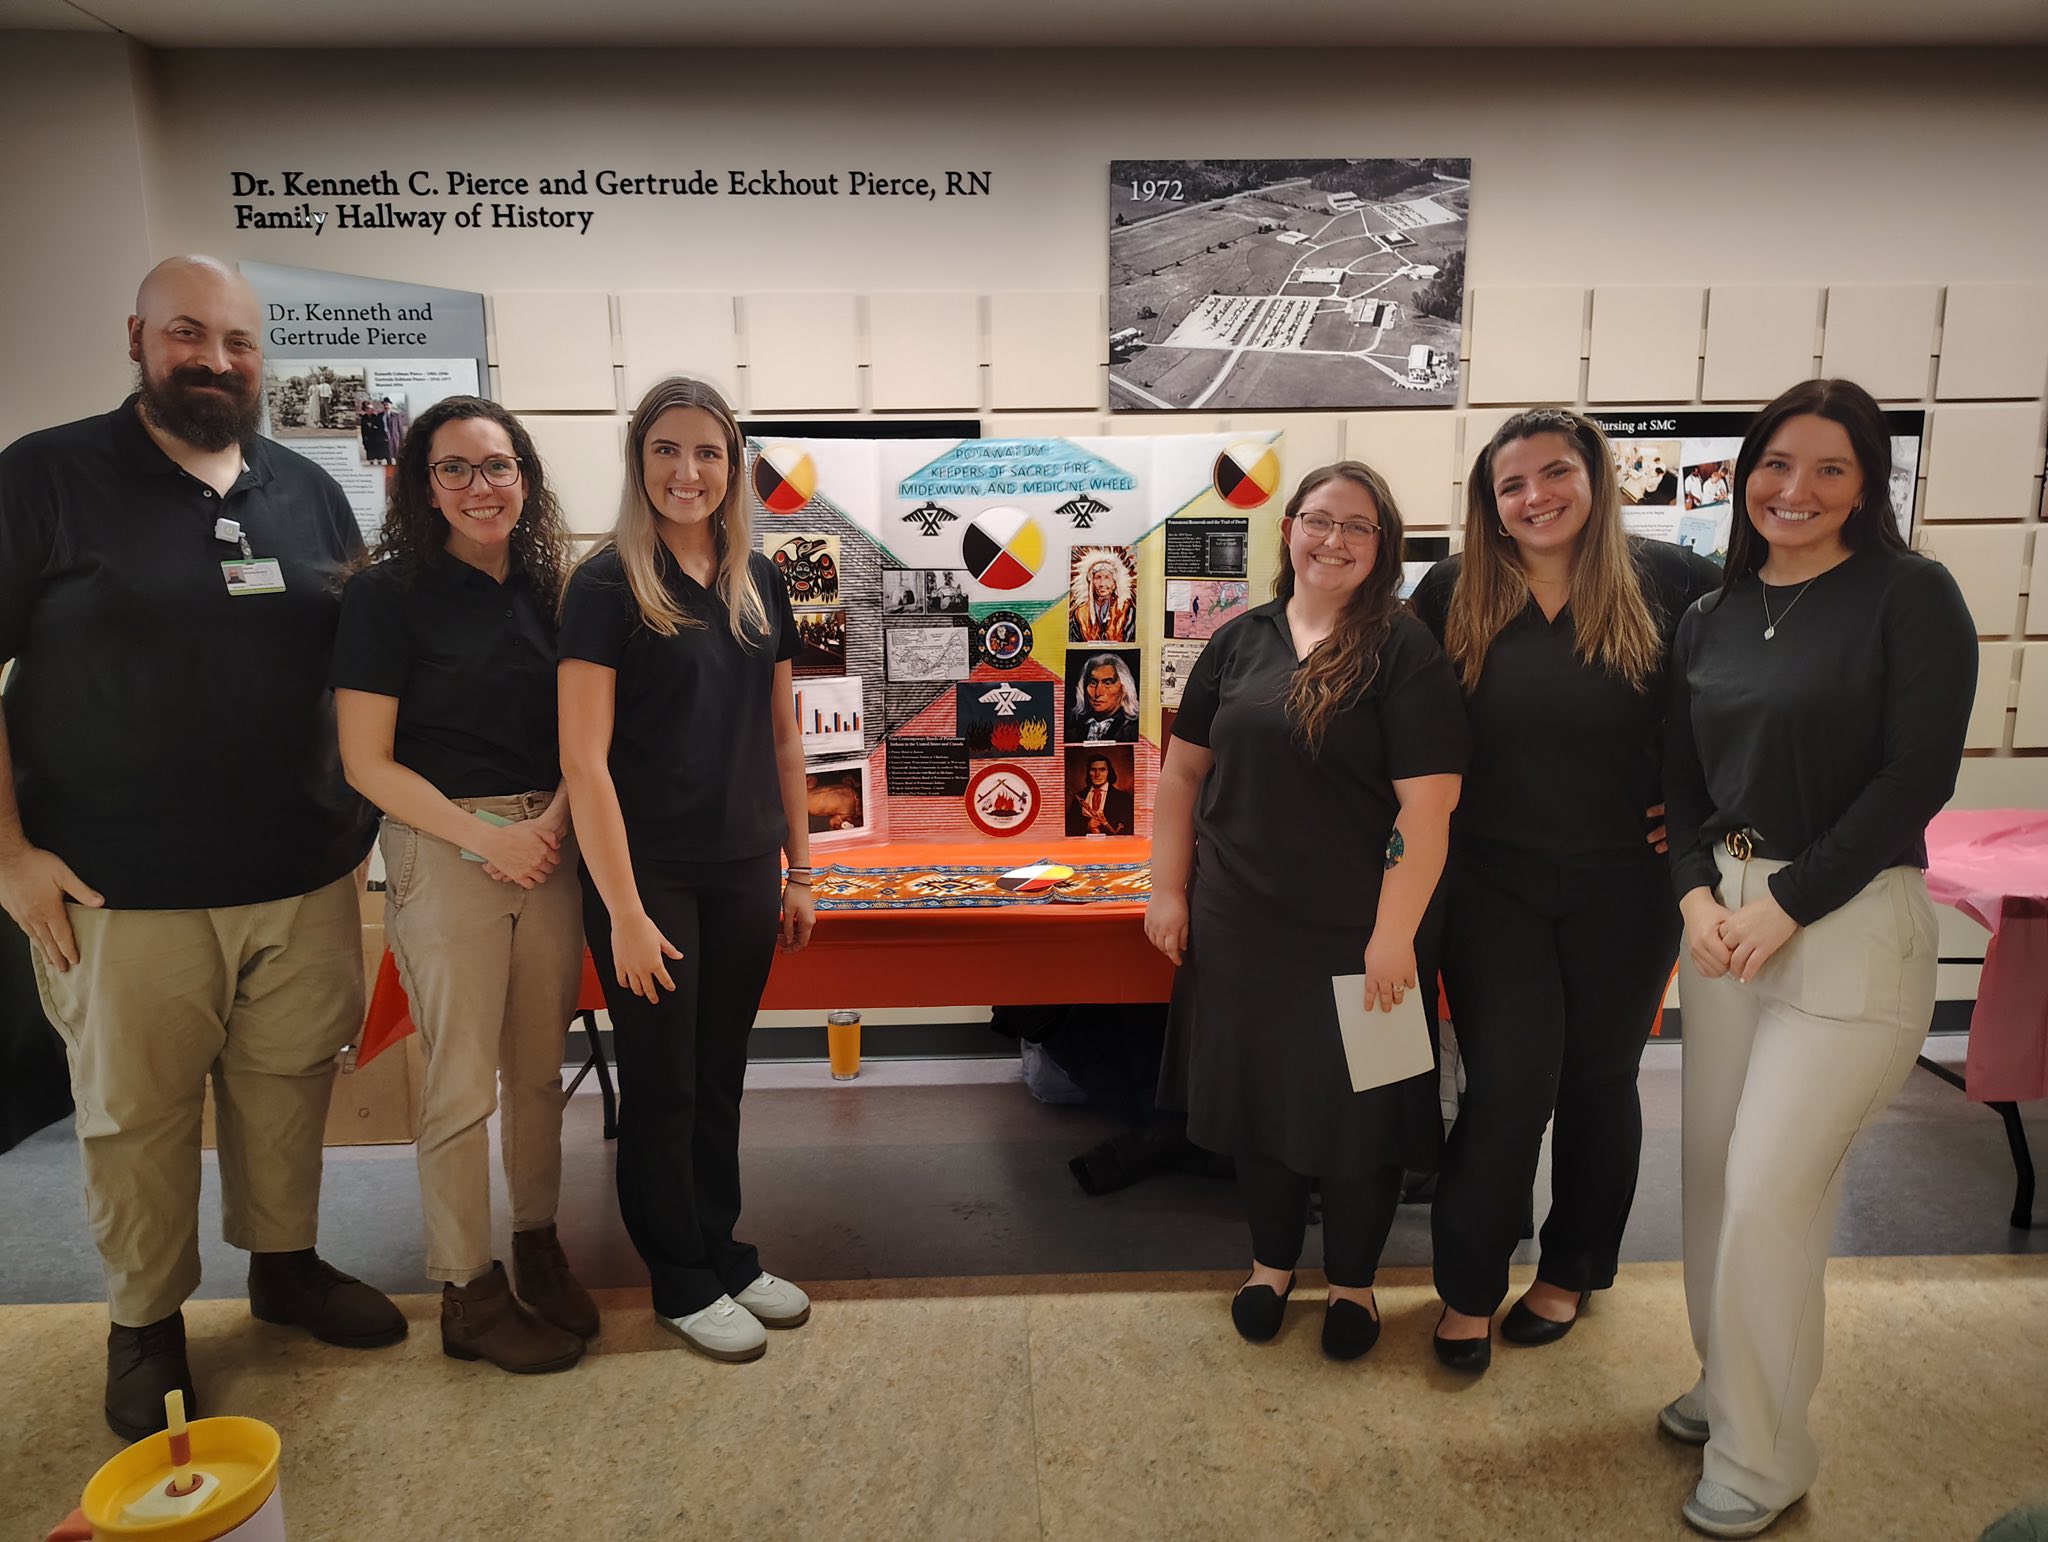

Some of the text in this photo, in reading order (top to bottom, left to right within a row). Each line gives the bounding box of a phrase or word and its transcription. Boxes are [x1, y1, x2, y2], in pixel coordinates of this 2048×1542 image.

[231, 169, 992, 201] Dr. Kenneth C. Pierce and Gertrude Eckhout Pierce, RN
[1130, 180, 1185, 202] 1972
[234, 202, 594, 236] Family Hallway of History
[267, 303, 433, 321] Dr. Kenneth and
[270, 327, 427, 346] Gertrude Pierce
[1595, 419, 1677, 434] Nursing at SMC
[956, 444, 1046, 460] POTAWATOM
[931, 465, 985, 479] KEEPERS
[988, 463, 1007, 479] OF
[1010, 463, 1059, 478] SACRED
[988, 481, 1016, 495] AND
[1023, 479, 1086, 494] MEDICINE
[1089, 476, 1136, 491] WHEEL
